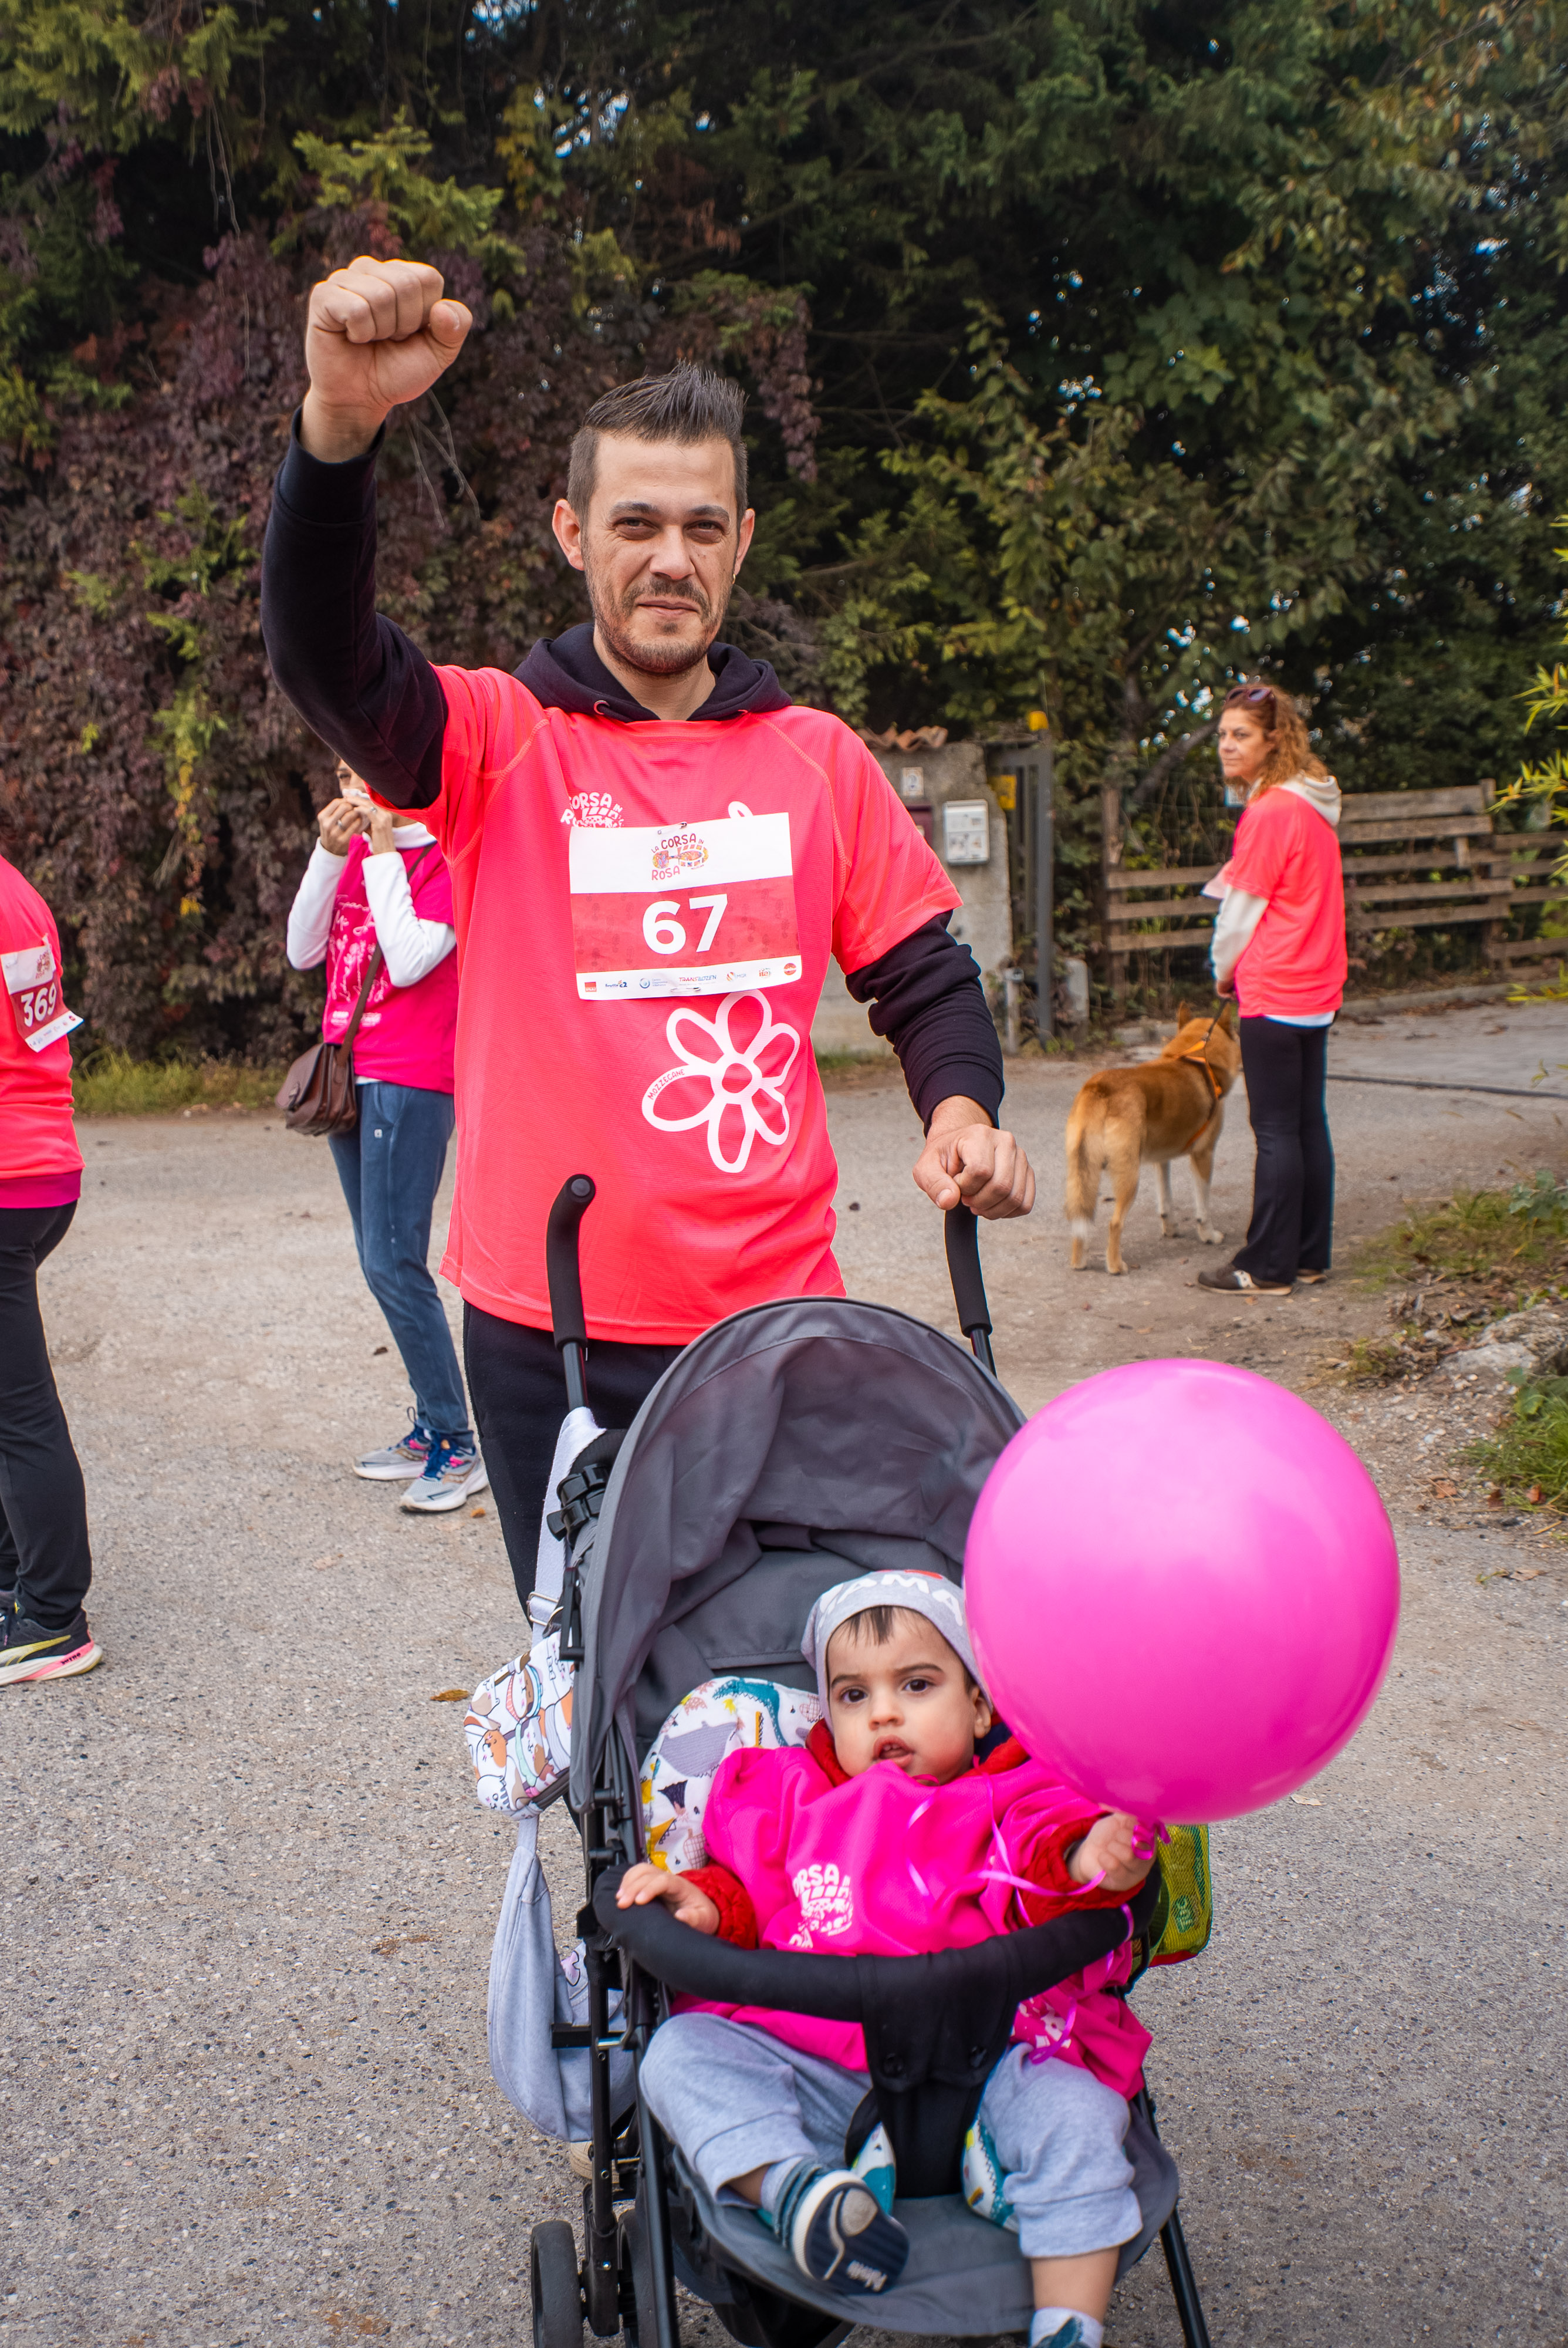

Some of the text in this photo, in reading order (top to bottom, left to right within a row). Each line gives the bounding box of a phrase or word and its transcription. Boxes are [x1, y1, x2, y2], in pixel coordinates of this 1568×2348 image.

[661, 833, 697, 849] CORSA
[651, 865, 680, 880] ROSA
[643, 893, 728, 955] 67
[21, 981, 57, 1027] 369
[647, 1069, 685, 1100] MOZZECANE
[793, 1863, 840, 1898] ORSA
